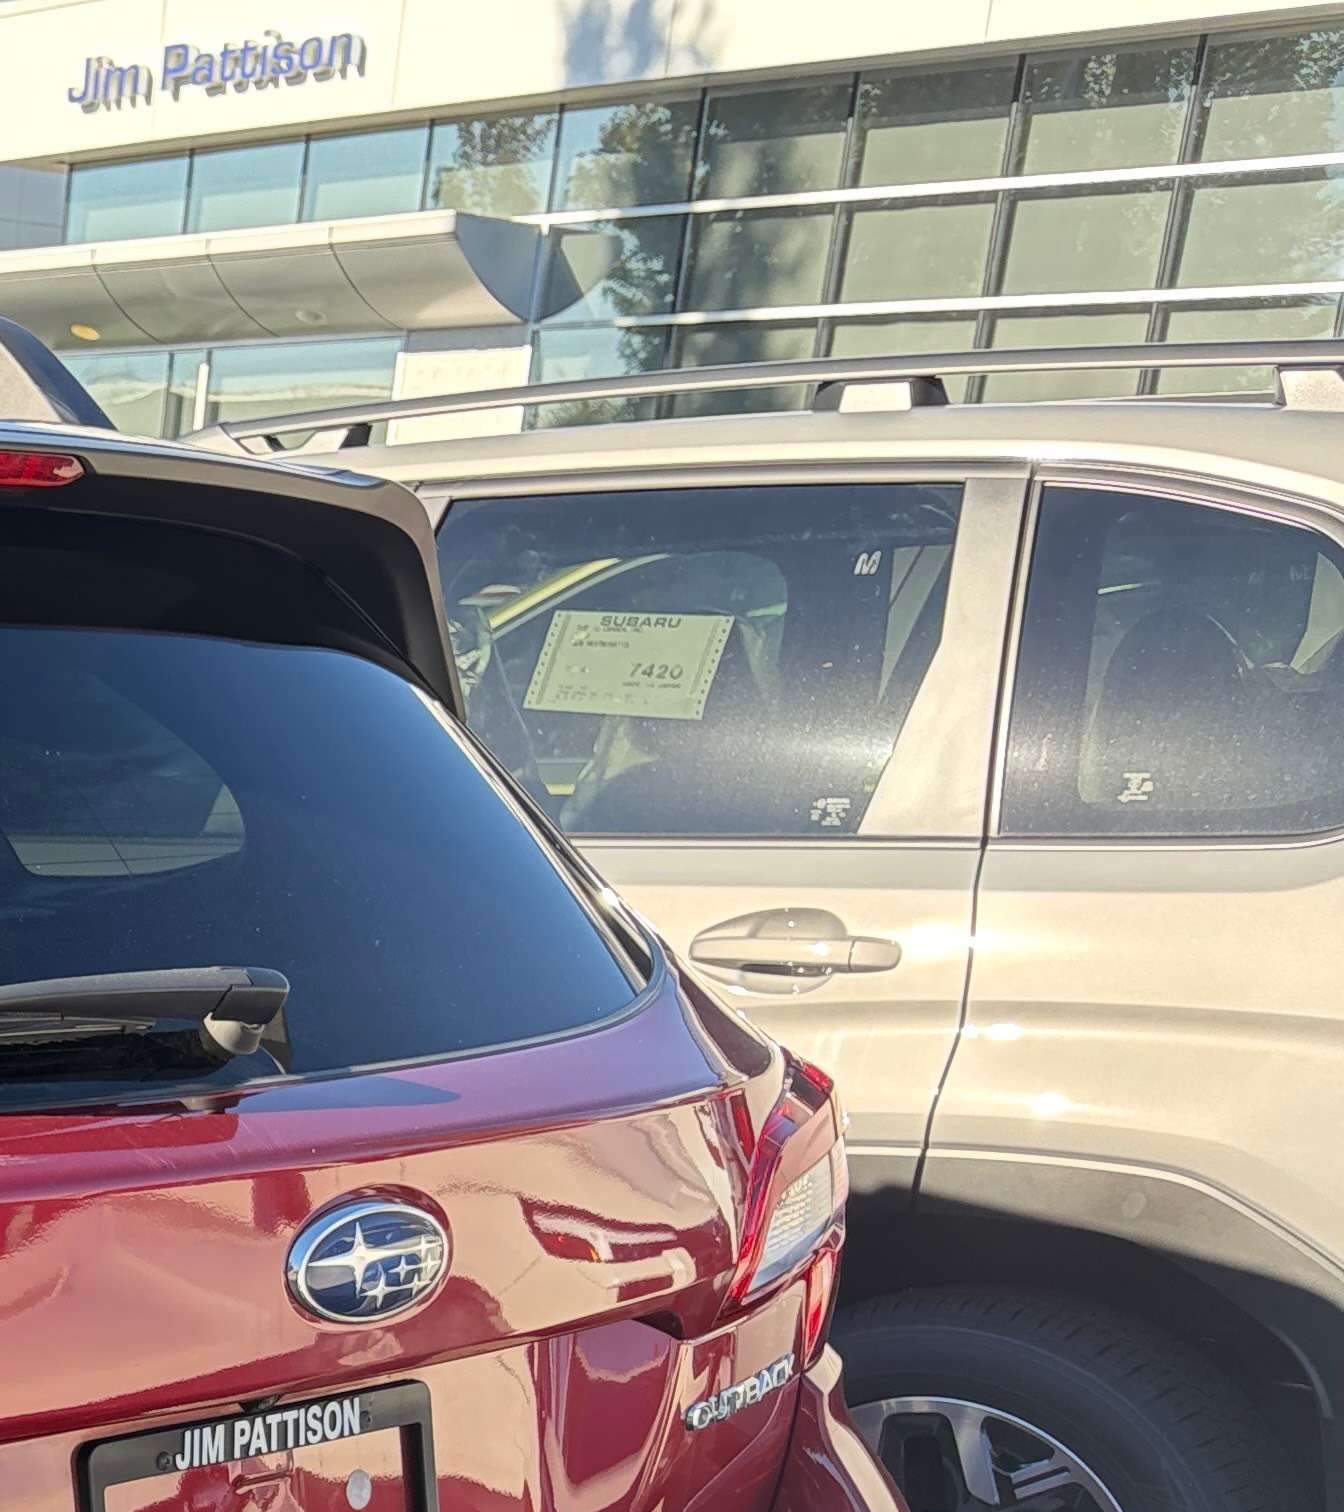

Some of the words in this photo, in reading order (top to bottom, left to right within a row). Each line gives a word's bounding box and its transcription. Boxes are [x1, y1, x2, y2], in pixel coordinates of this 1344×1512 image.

[68, 57, 153, 113] Jim
[162, 31, 368, 103] Pattison
[600, 615, 682, 629] SUBARU
[629, 662, 684, 680] 7420
[685, 1352, 795, 1430] OUTBACK
[175, 1424, 225, 1470] JIM
[233, 1397, 361, 1460] PATTISON
